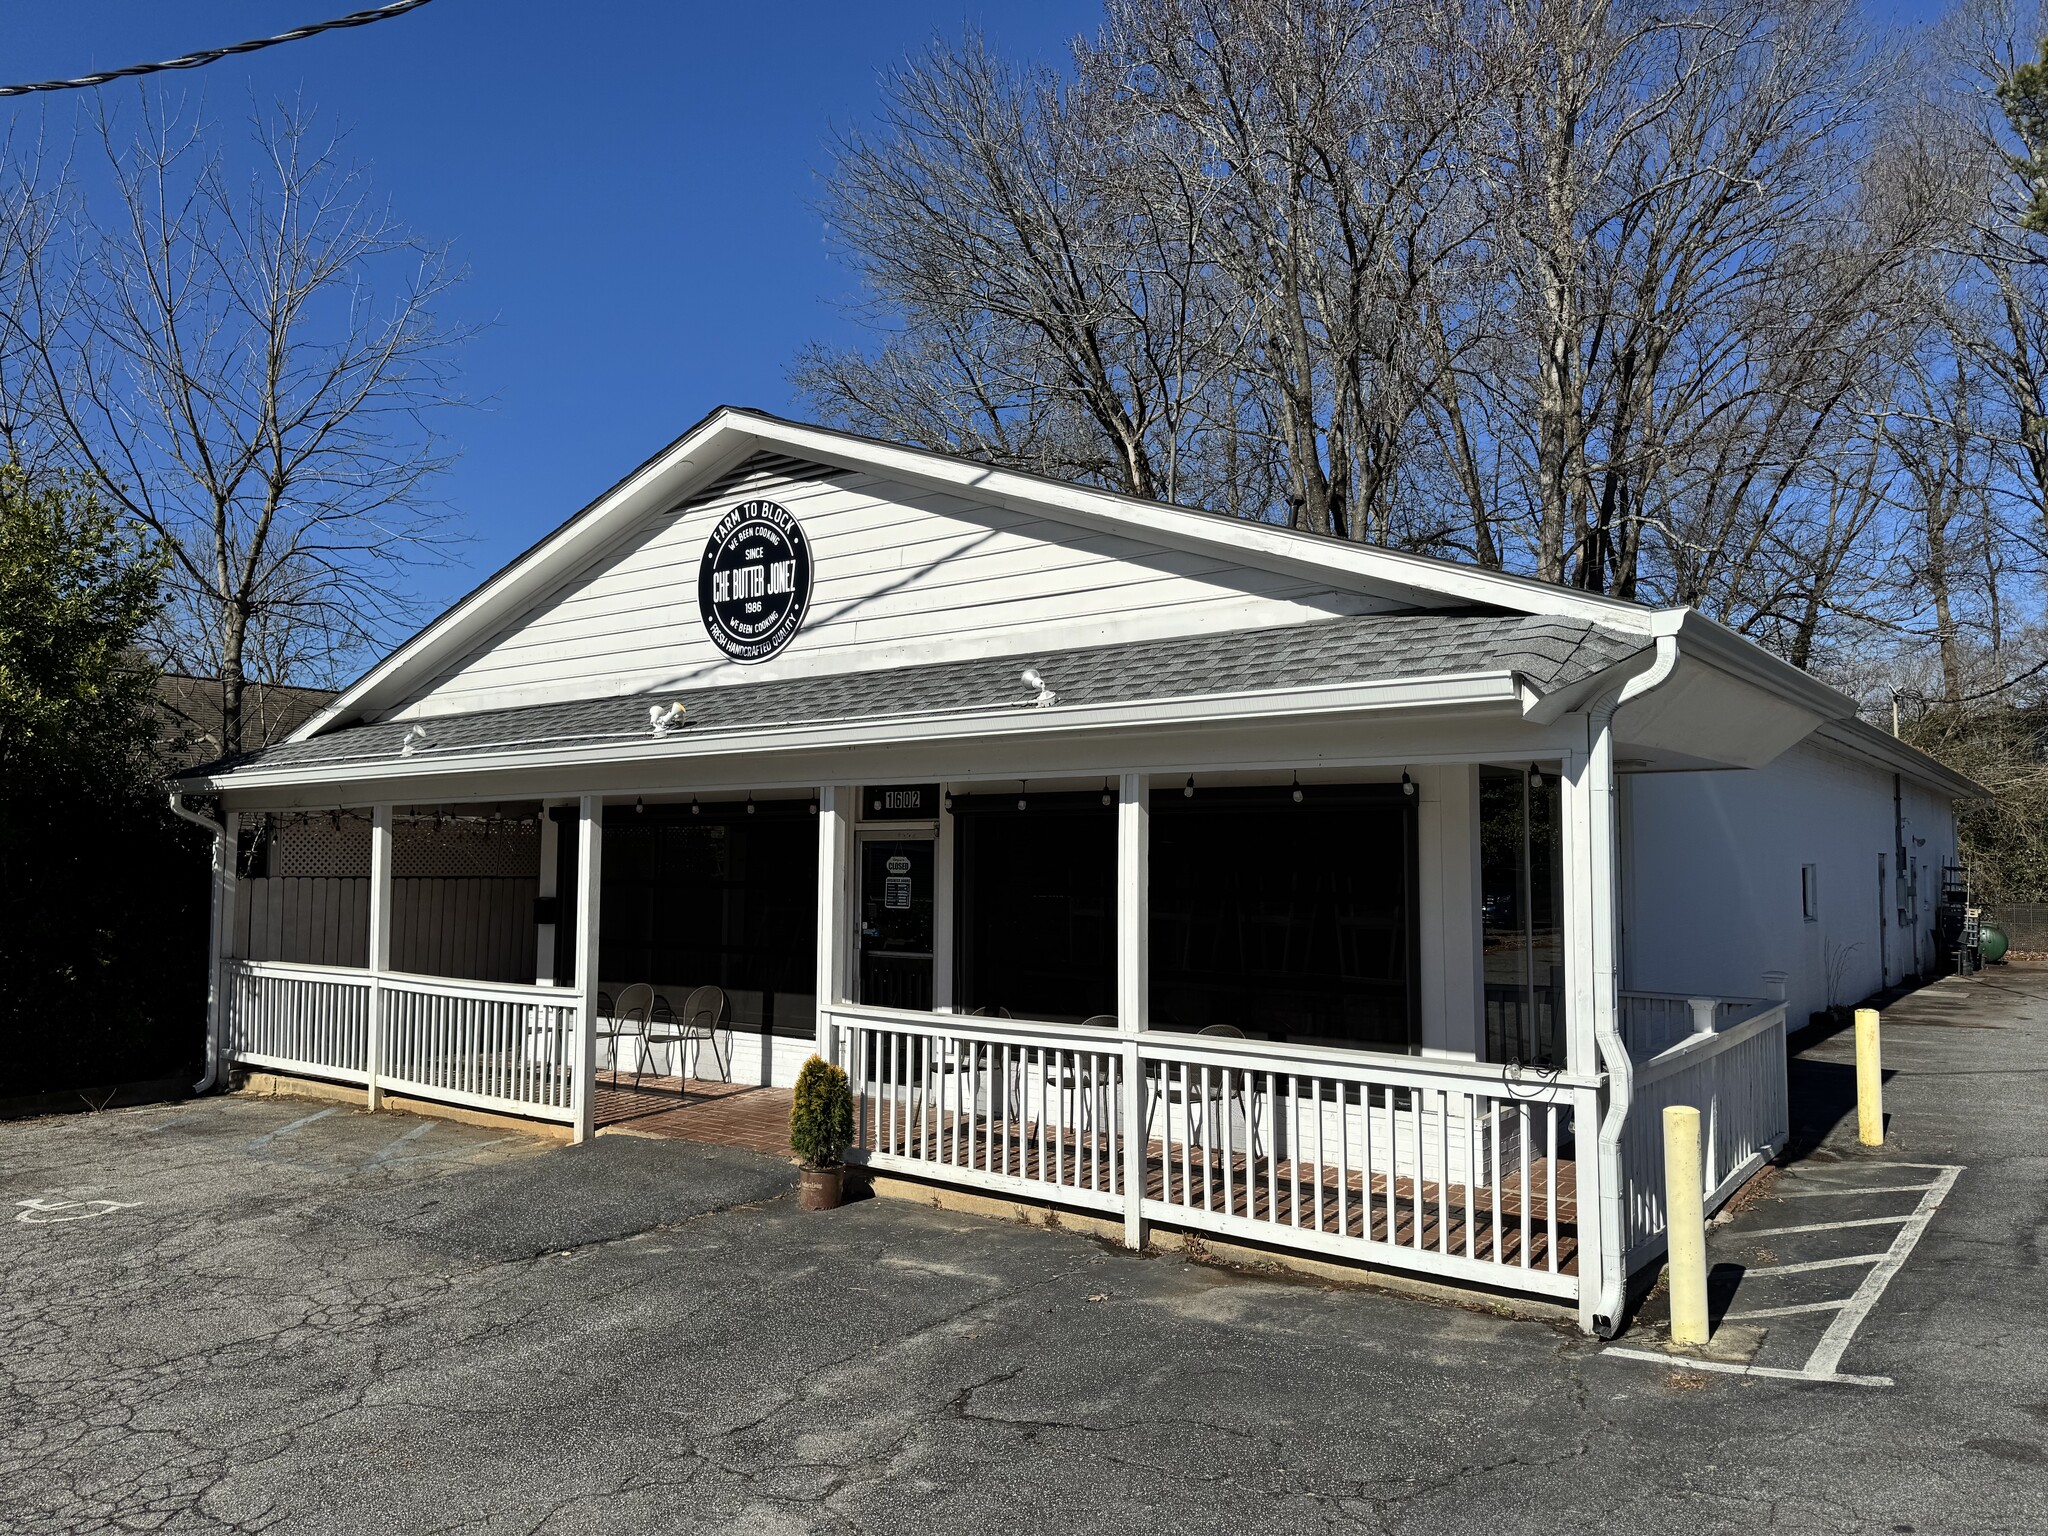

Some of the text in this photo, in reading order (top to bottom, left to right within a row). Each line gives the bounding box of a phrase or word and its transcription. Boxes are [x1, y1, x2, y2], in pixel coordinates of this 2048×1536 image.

[713, 502, 795, 544] FARM TO BLOCK
[728, 526, 781, 551] WE BEEN COOKING
[745, 546, 764, 560] SINCE
[713, 559, 797, 603] CHE BUTTER JONEZ
[745, 601, 762, 614] 1986
[729, 610, 779, 634] WE BEEN COOKING
[710, 612, 797, 657] FRESH HANDCRAFTED QUALITY
[886, 791, 920, 808] 1602
[888, 861, 909, 871] CLOSED
